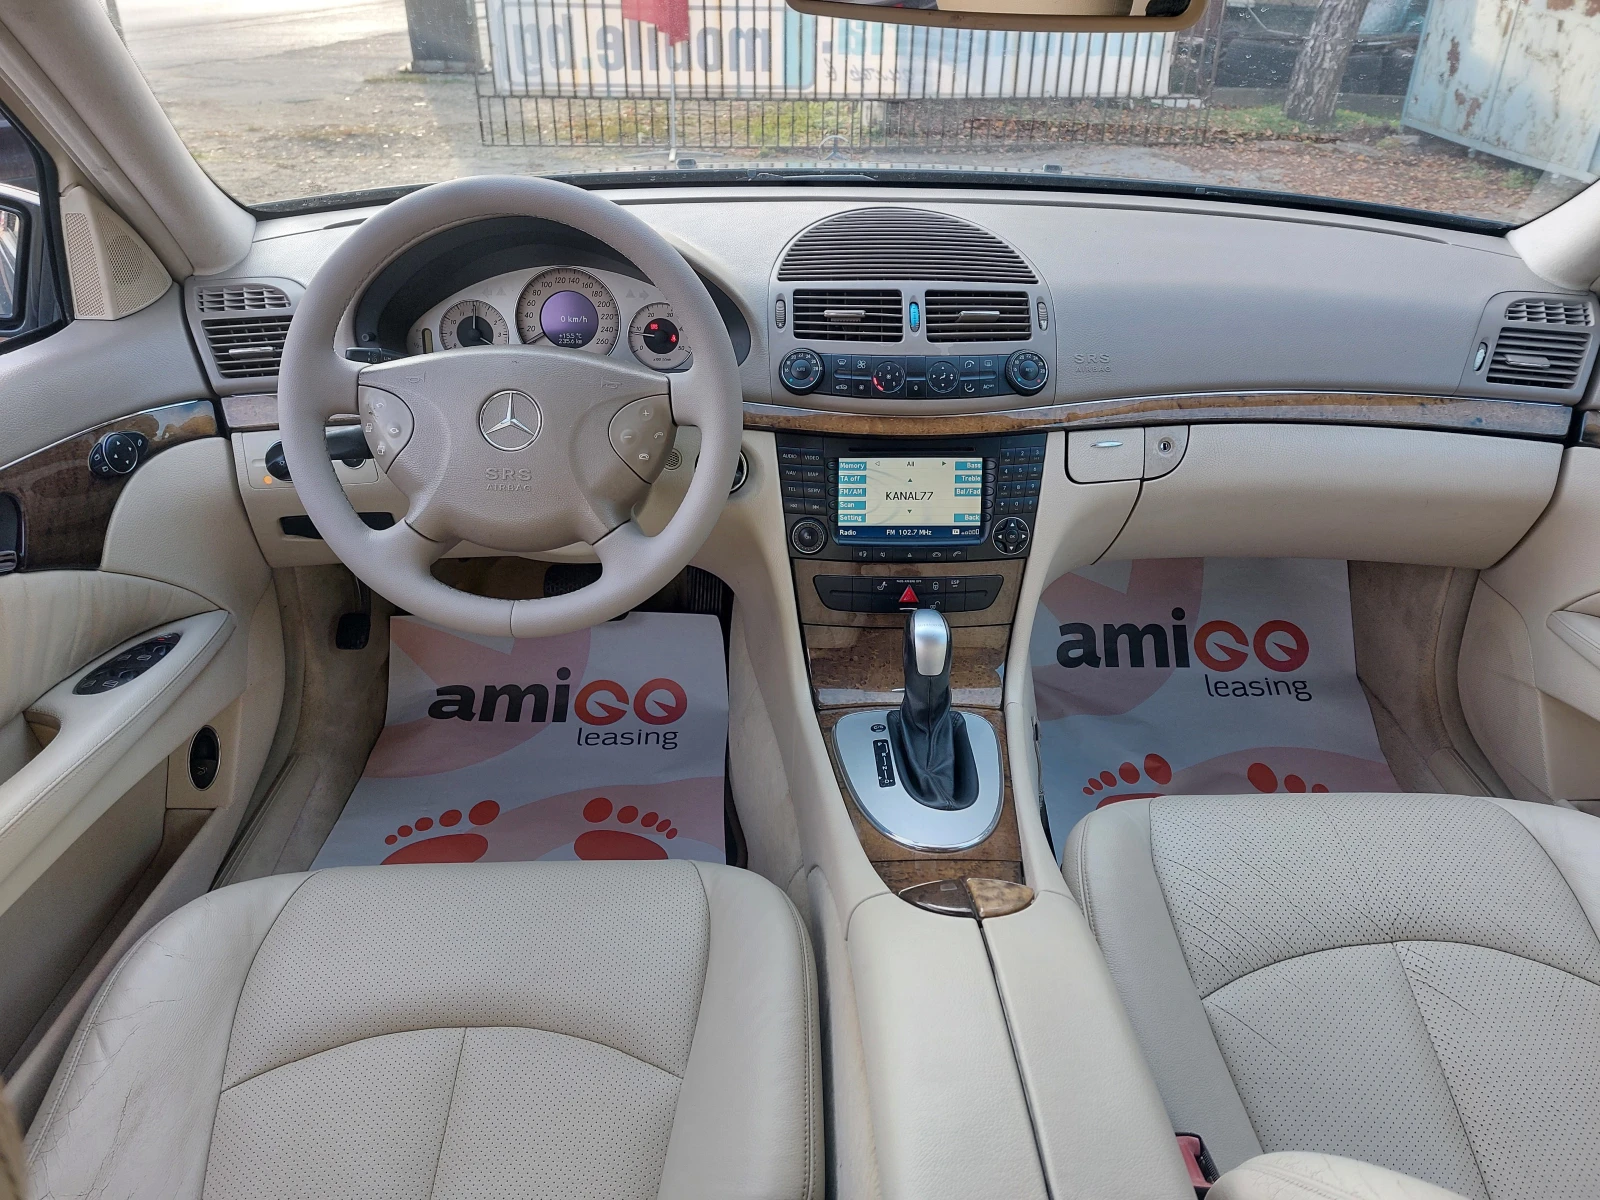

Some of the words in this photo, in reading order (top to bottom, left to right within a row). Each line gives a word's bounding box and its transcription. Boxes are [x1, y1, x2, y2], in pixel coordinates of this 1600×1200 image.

[1074, 354, 1110, 364] SRS
[485, 467, 532, 481] SRS
[486, 483, 532, 492] AIRBAG
[885, 491, 934, 501] KANAL77
[1056, 607, 1310, 672] amiGO
[427, 666, 688, 726] amiGO
[1204, 674, 1313, 702] leasing
[576, 728, 679, 750] leasing
